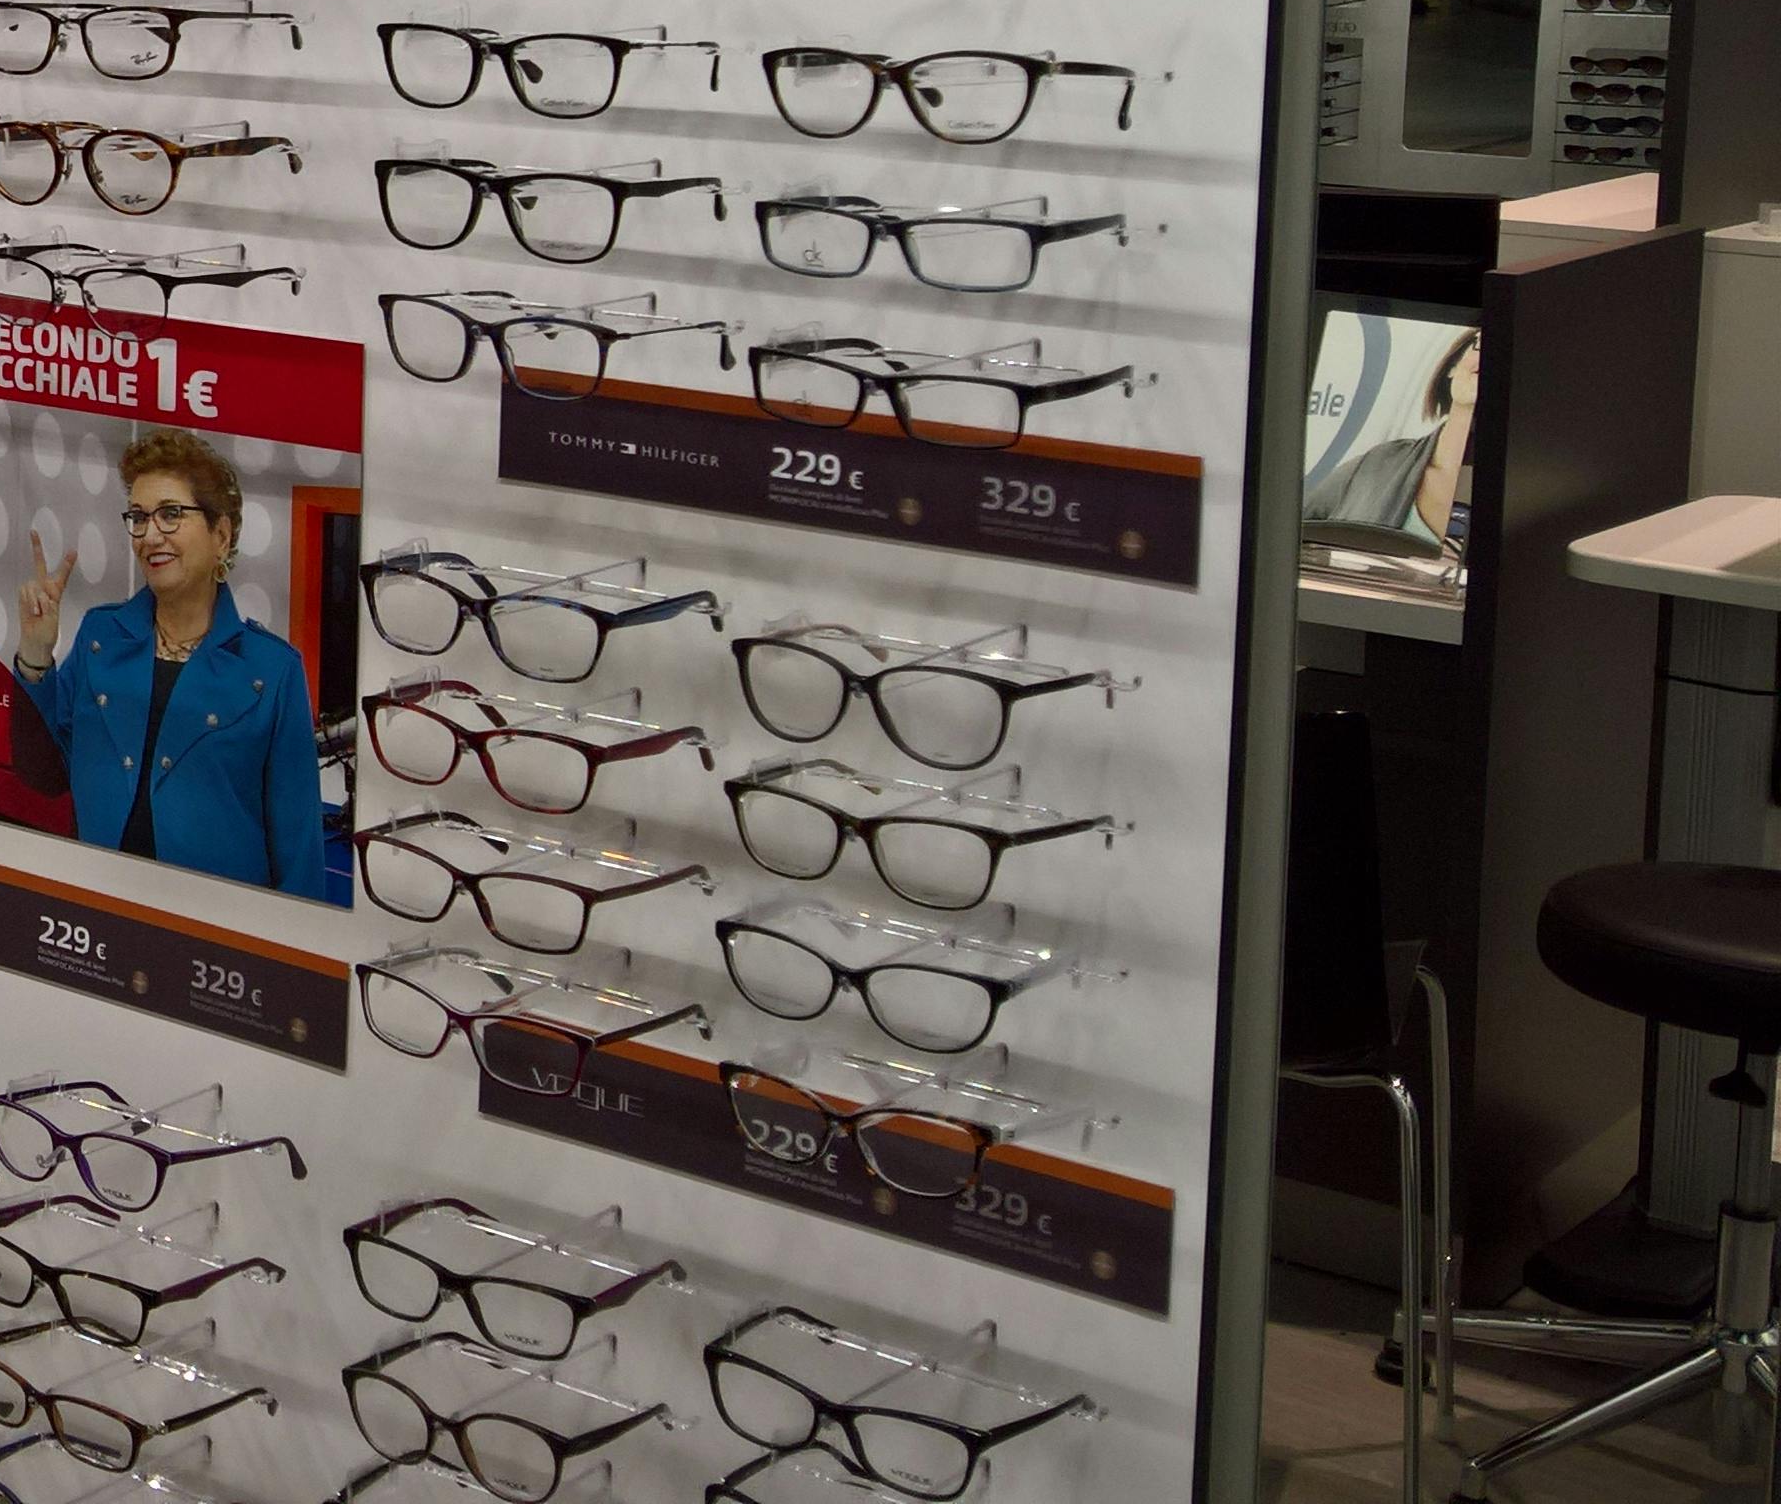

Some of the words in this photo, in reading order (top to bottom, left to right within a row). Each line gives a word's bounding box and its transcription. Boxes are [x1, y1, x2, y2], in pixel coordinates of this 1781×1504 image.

[146, 338, 218, 418] 1€
[548, 431, 616, 453] TOMMY
[641, 445, 720, 469] HILFIGER
[769, 447, 841, 487] 229
[38, 916, 90, 954] 229
